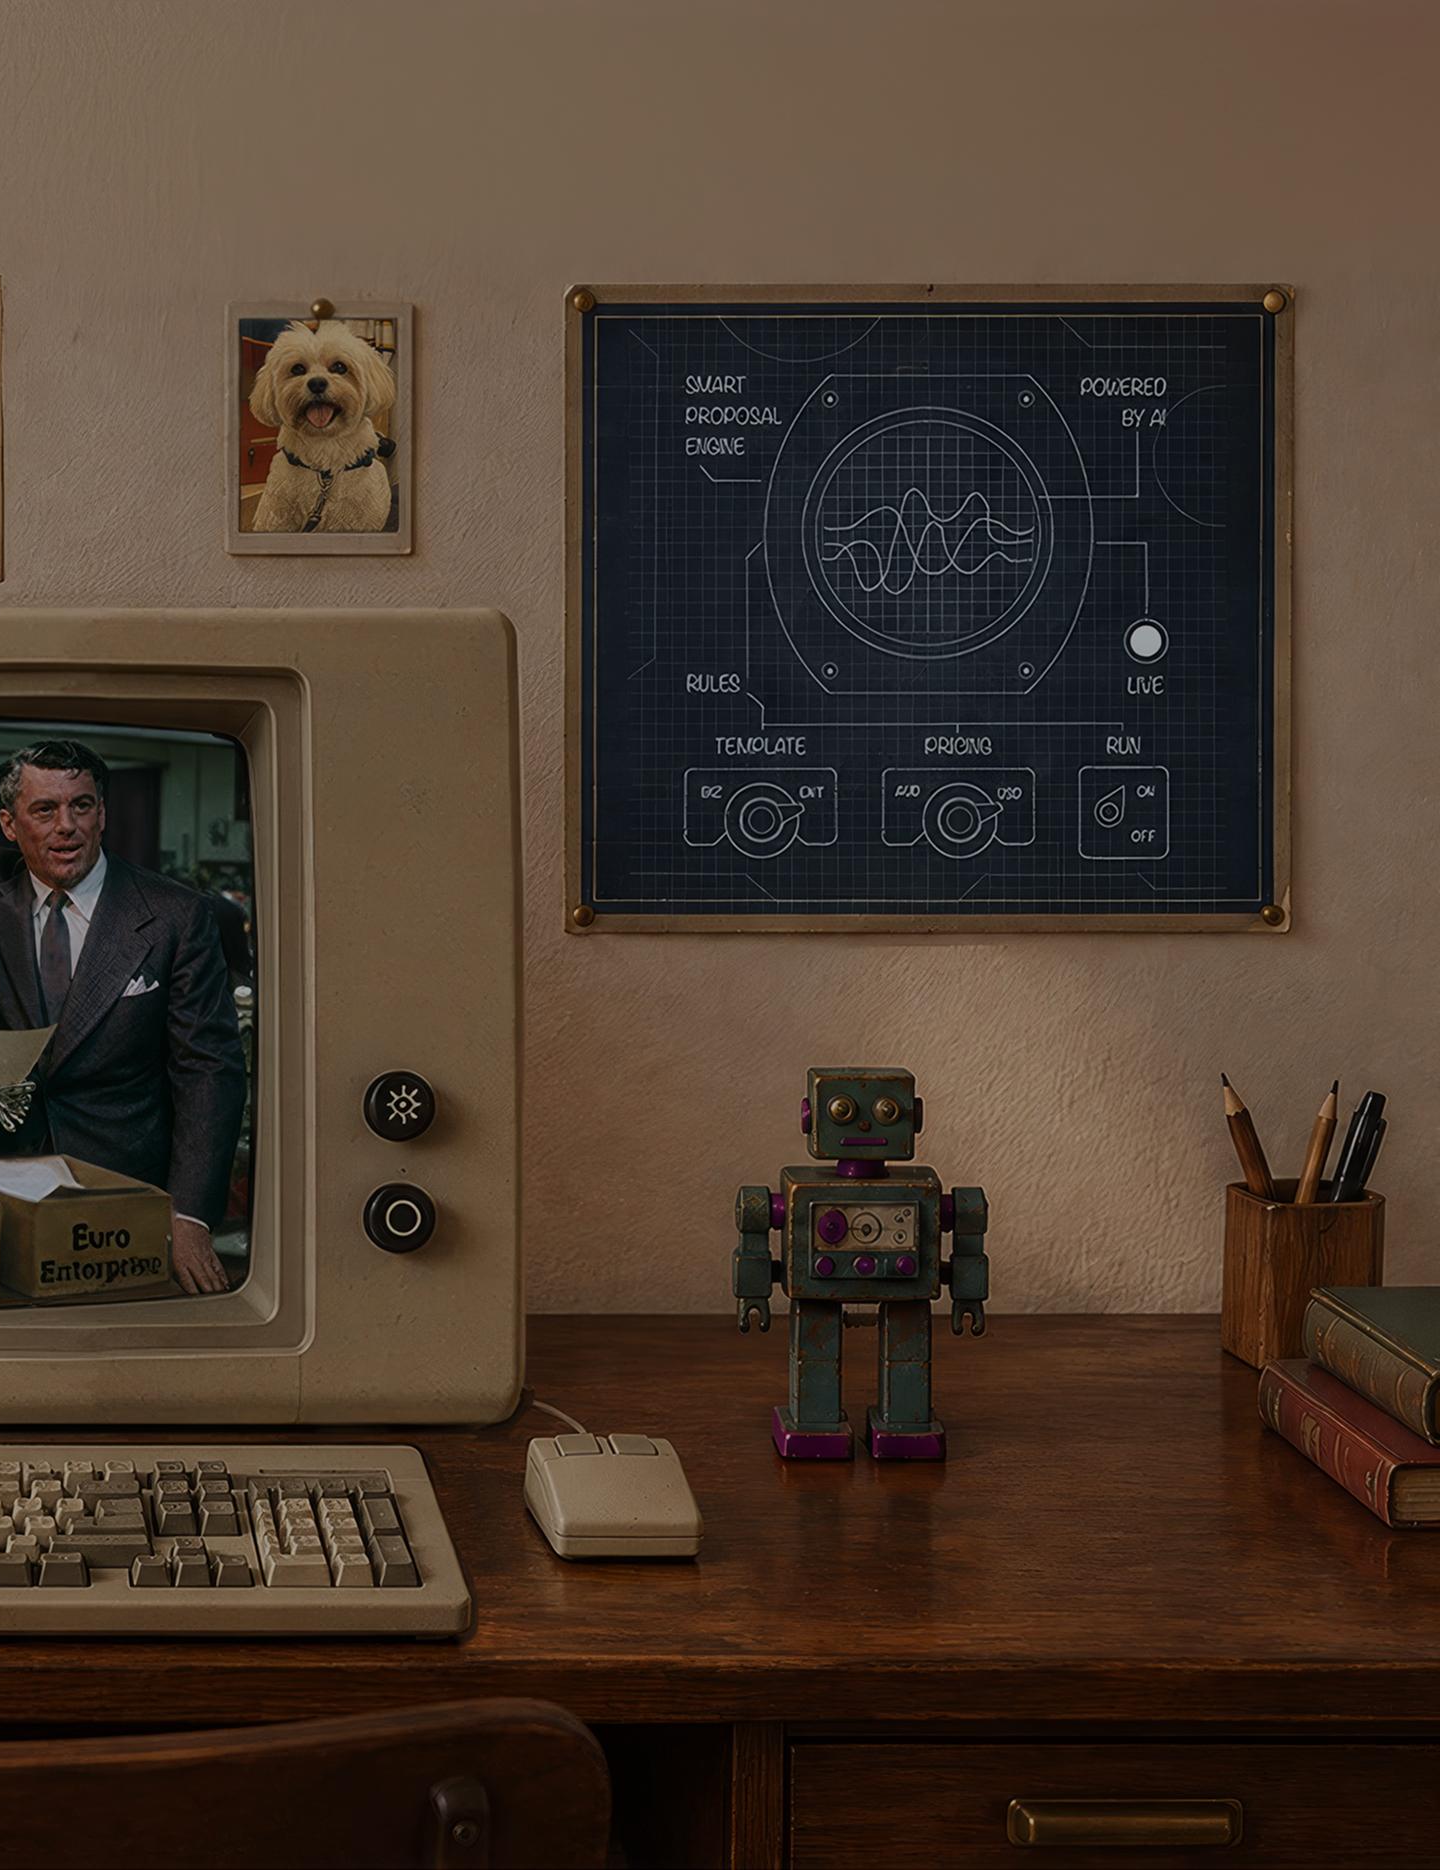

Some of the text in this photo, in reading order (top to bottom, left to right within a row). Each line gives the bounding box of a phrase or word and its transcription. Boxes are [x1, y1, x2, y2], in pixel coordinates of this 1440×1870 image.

[1080, 377, 1167, 397] POWERED
[685, 406, 783, 426] PROPOSAL
[1122, 408, 1167, 428] BY AI
[685, 437, 745, 456] ENGINE
[687, 673, 741, 693] RULES
[1127, 675, 1164, 695] LIVE
[924, 736, 993, 756] PRICING
[1106, 736, 1141, 755] RUN
[1130, 829, 1157, 843] OFF
[72, 1223, 131, 1251] Euro
